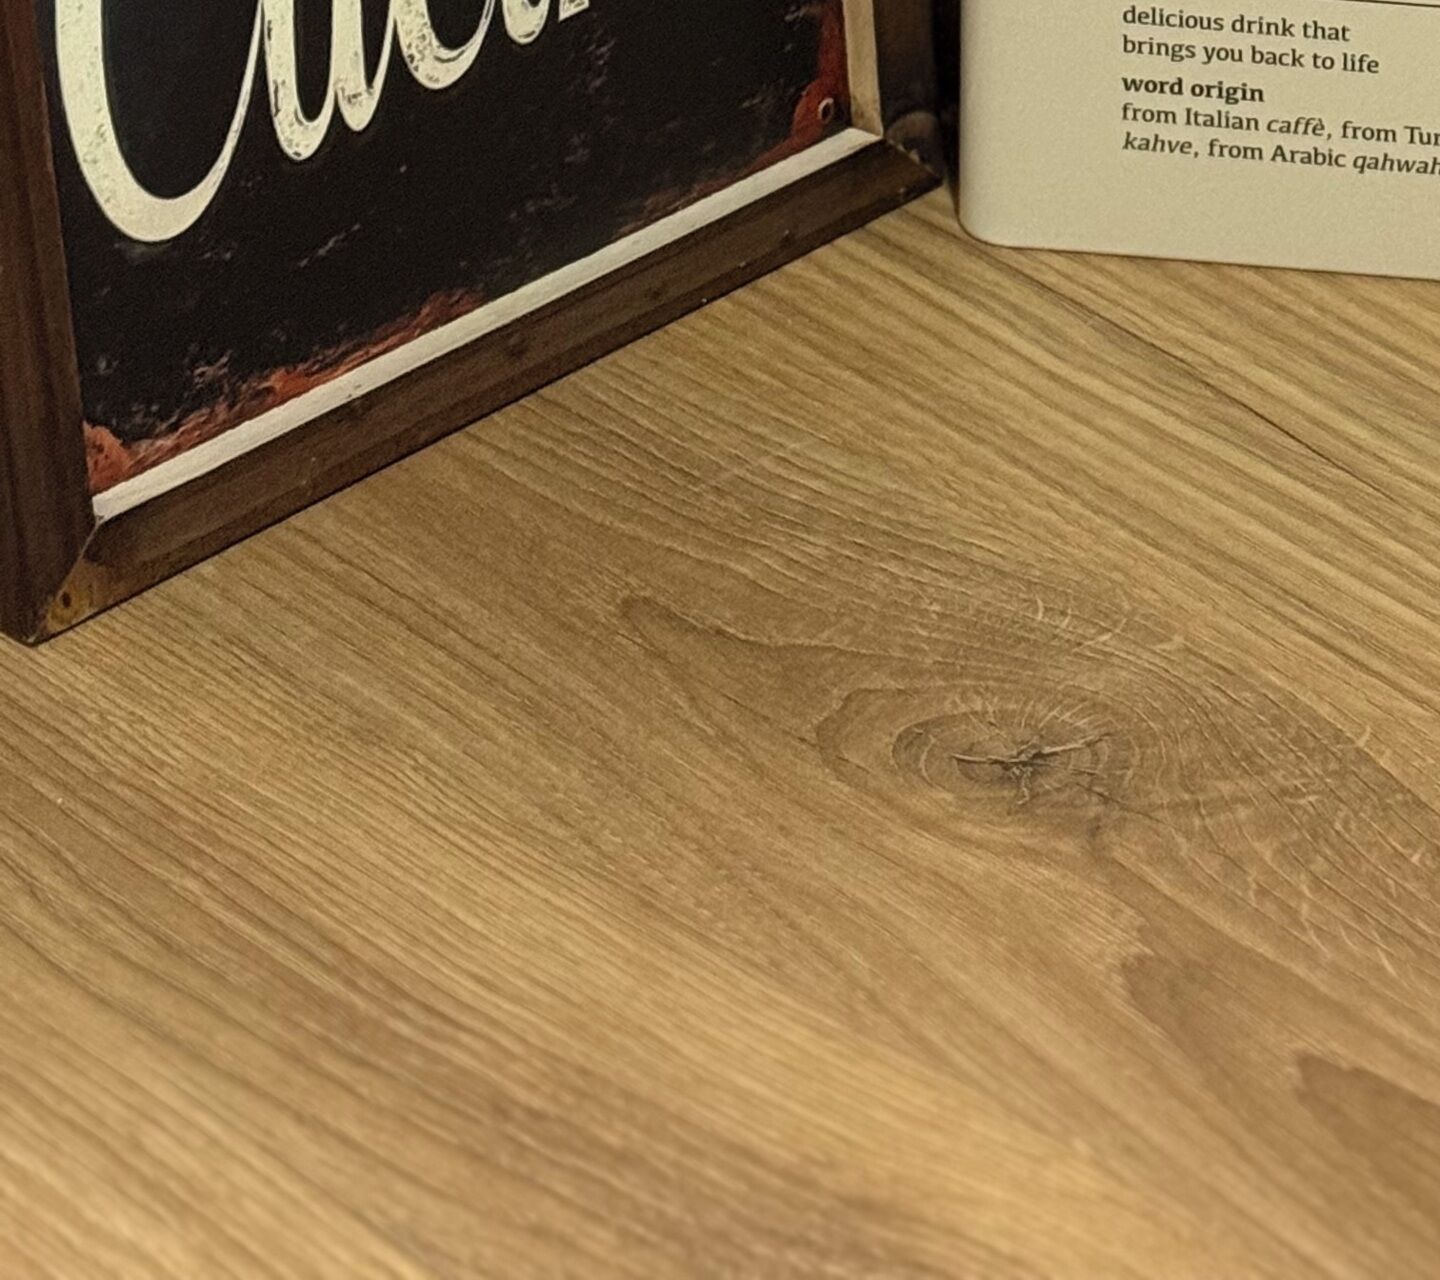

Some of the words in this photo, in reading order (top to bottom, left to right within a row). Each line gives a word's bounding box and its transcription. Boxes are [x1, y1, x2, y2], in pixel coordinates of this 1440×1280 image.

[1122, 4, 1225, 32] delicious
[1230, 13, 1296, 38] drink
[1302, 19, 1351, 43] that
[1122, 33, 1197, 63] brings
[1202, 45, 1244, 66] you
[1250, 44, 1305, 69] back
[1311, 52, 1336, 71] to
[1341, 51, 1380, 74] life
[1121, 75, 1185, 96] word
[1189, 80, 1265, 106] origin
[1121, 102, 1178, 125] from
[1184, 107, 1260, 132] Italian
[1266, 116, 1333, 142] caffè,
[1340, 120, 1398, 144] from
[1121, 130, 1200, 159] kahve,
[1207, 137, 1264, 162] from
[1270, 144, 1347, 168] Arabic
